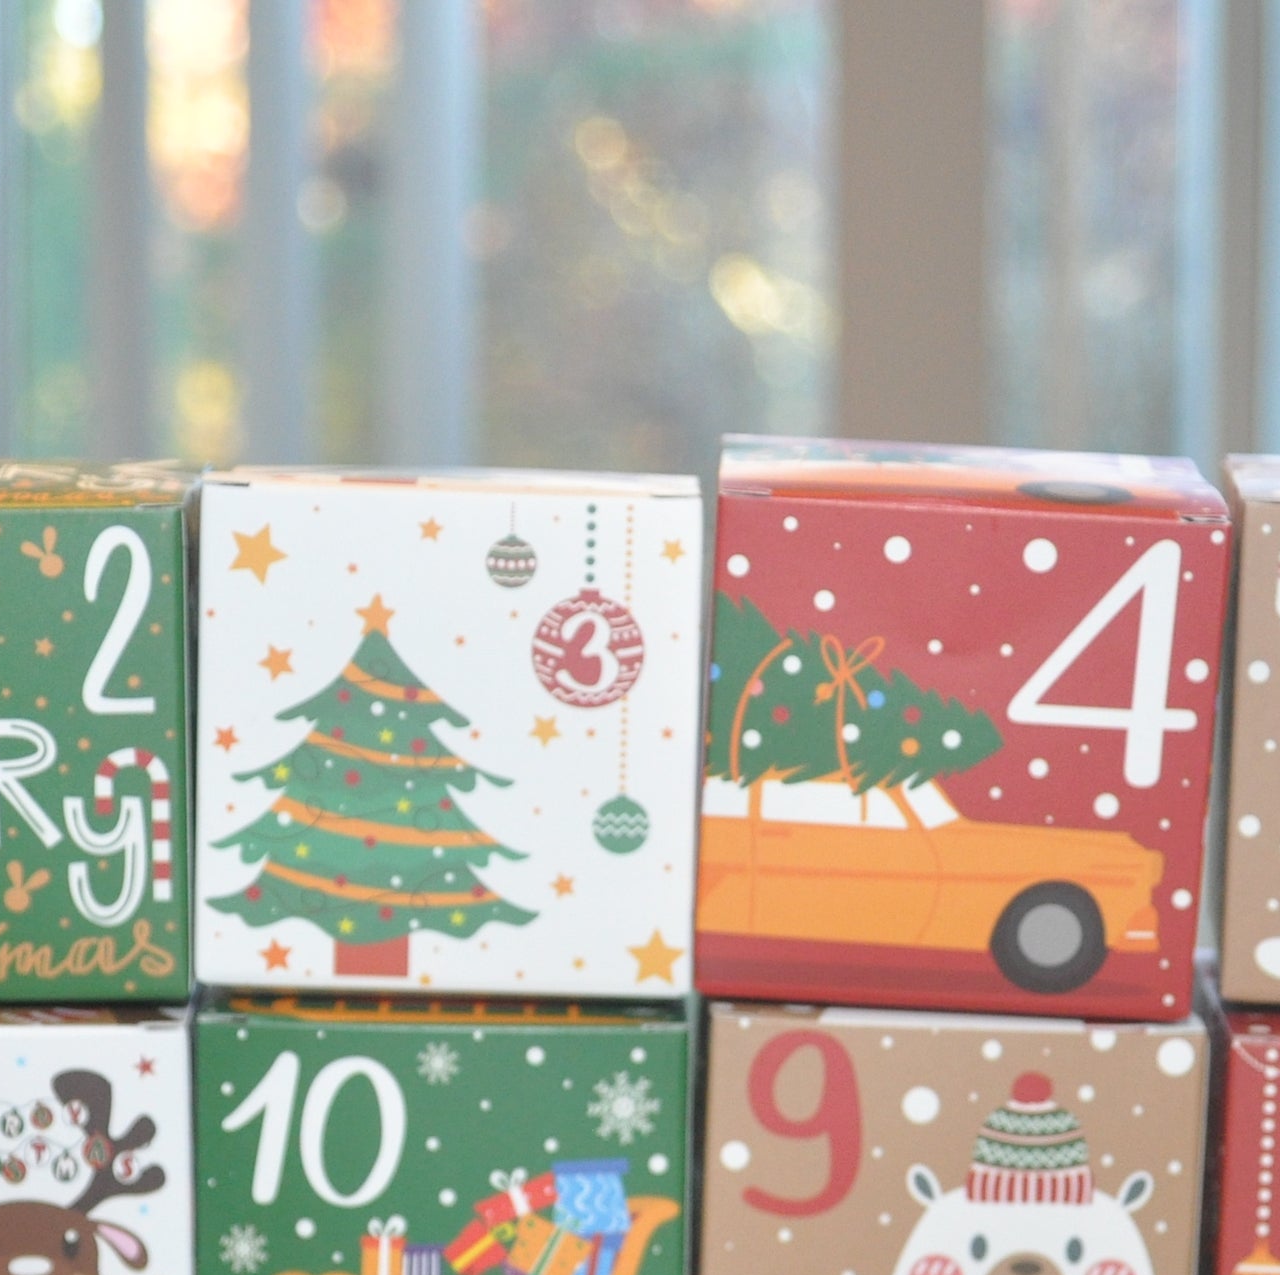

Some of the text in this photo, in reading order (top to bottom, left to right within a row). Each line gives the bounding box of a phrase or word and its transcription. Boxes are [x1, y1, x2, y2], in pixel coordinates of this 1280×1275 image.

[83, 525, 156, 714] 2
[556, 607, 618, 695] 3
[1007, 538, 1198, 787] 4
[221, 1050, 408, 1208] 10
[742, 1029, 862, 1218] 9
